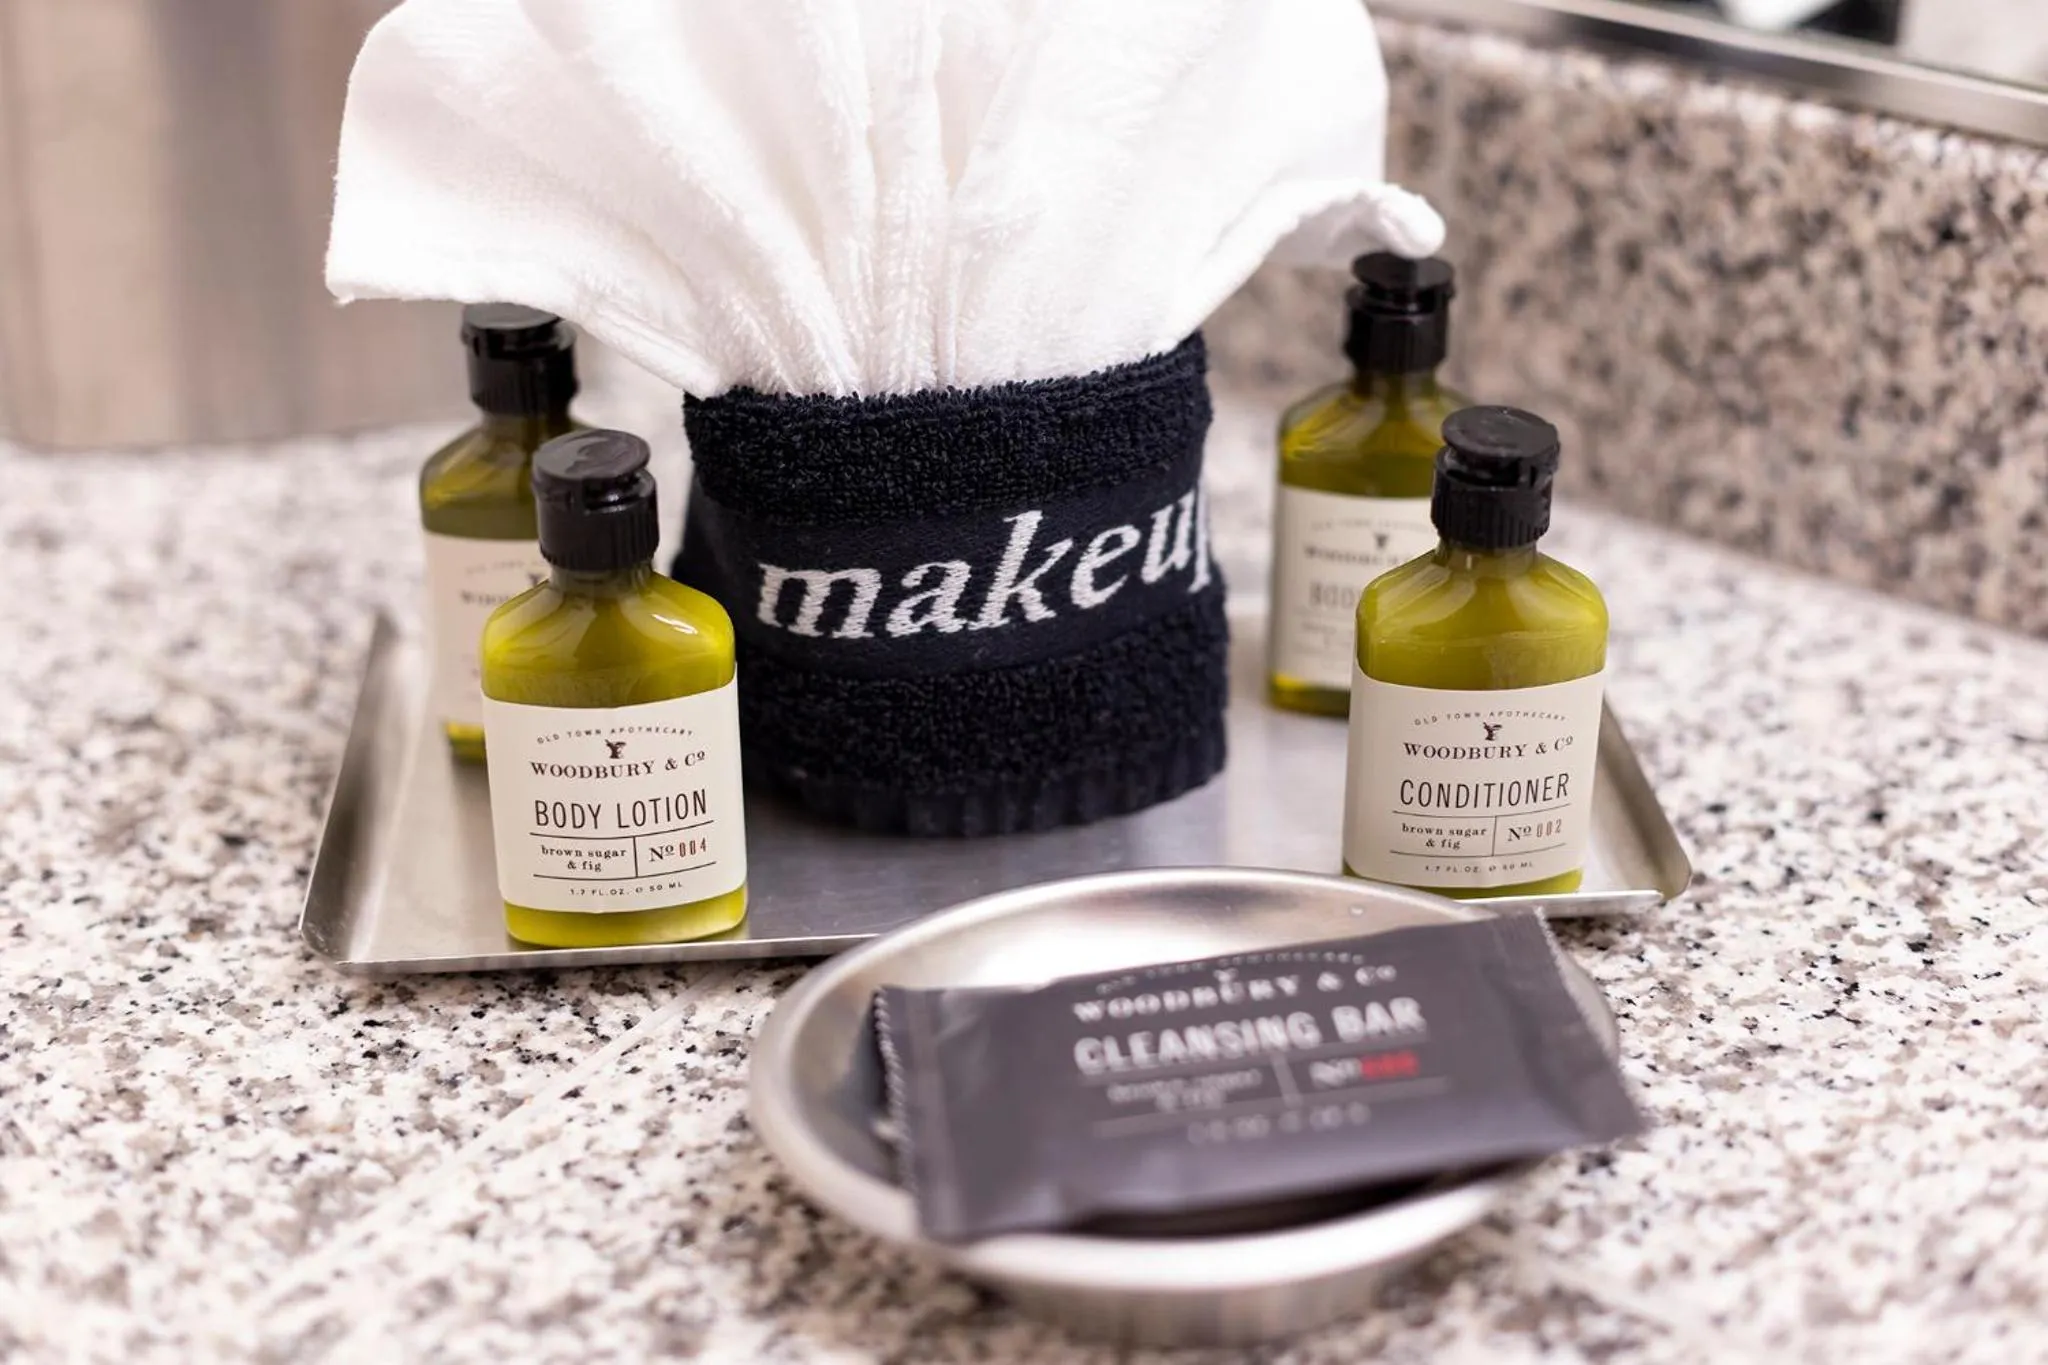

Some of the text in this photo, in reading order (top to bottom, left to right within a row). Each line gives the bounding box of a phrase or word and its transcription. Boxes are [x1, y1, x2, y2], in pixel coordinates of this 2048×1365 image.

[1414, 710, 1566, 726] OLD TOWN APOTHECARY
[537, 726, 693, 745] OLD TOWN APOTHECARY
[1403, 742, 1528, 760] WOODBURY
[1535, 742, 1548, 755] &
[530, 759, 655, 779] WOODBURY
[665, 757, 678, 771] &
[1400, 772, 1570, 809] CONDITIONER
[535, 788, 708, 830] BODY LOTION
[1402, 823, 1487, 838] brown sugar
[1536, 818, 1562, 839] 002
[541, 845, 627, 860] brown sugar
[679, 837, 706, 858] 004
[1425, 837, 1461, 850] & fig
[567, 860, 602, 872] & fig
[570, 888, 586, 896] 1.7
[649, 884, 663, 892] 50
[669, 881, 683, 889] ML
[1074, 1011, 1323, 1076] CLEANSING
[1330, 996, 1428, 1044] BAR
